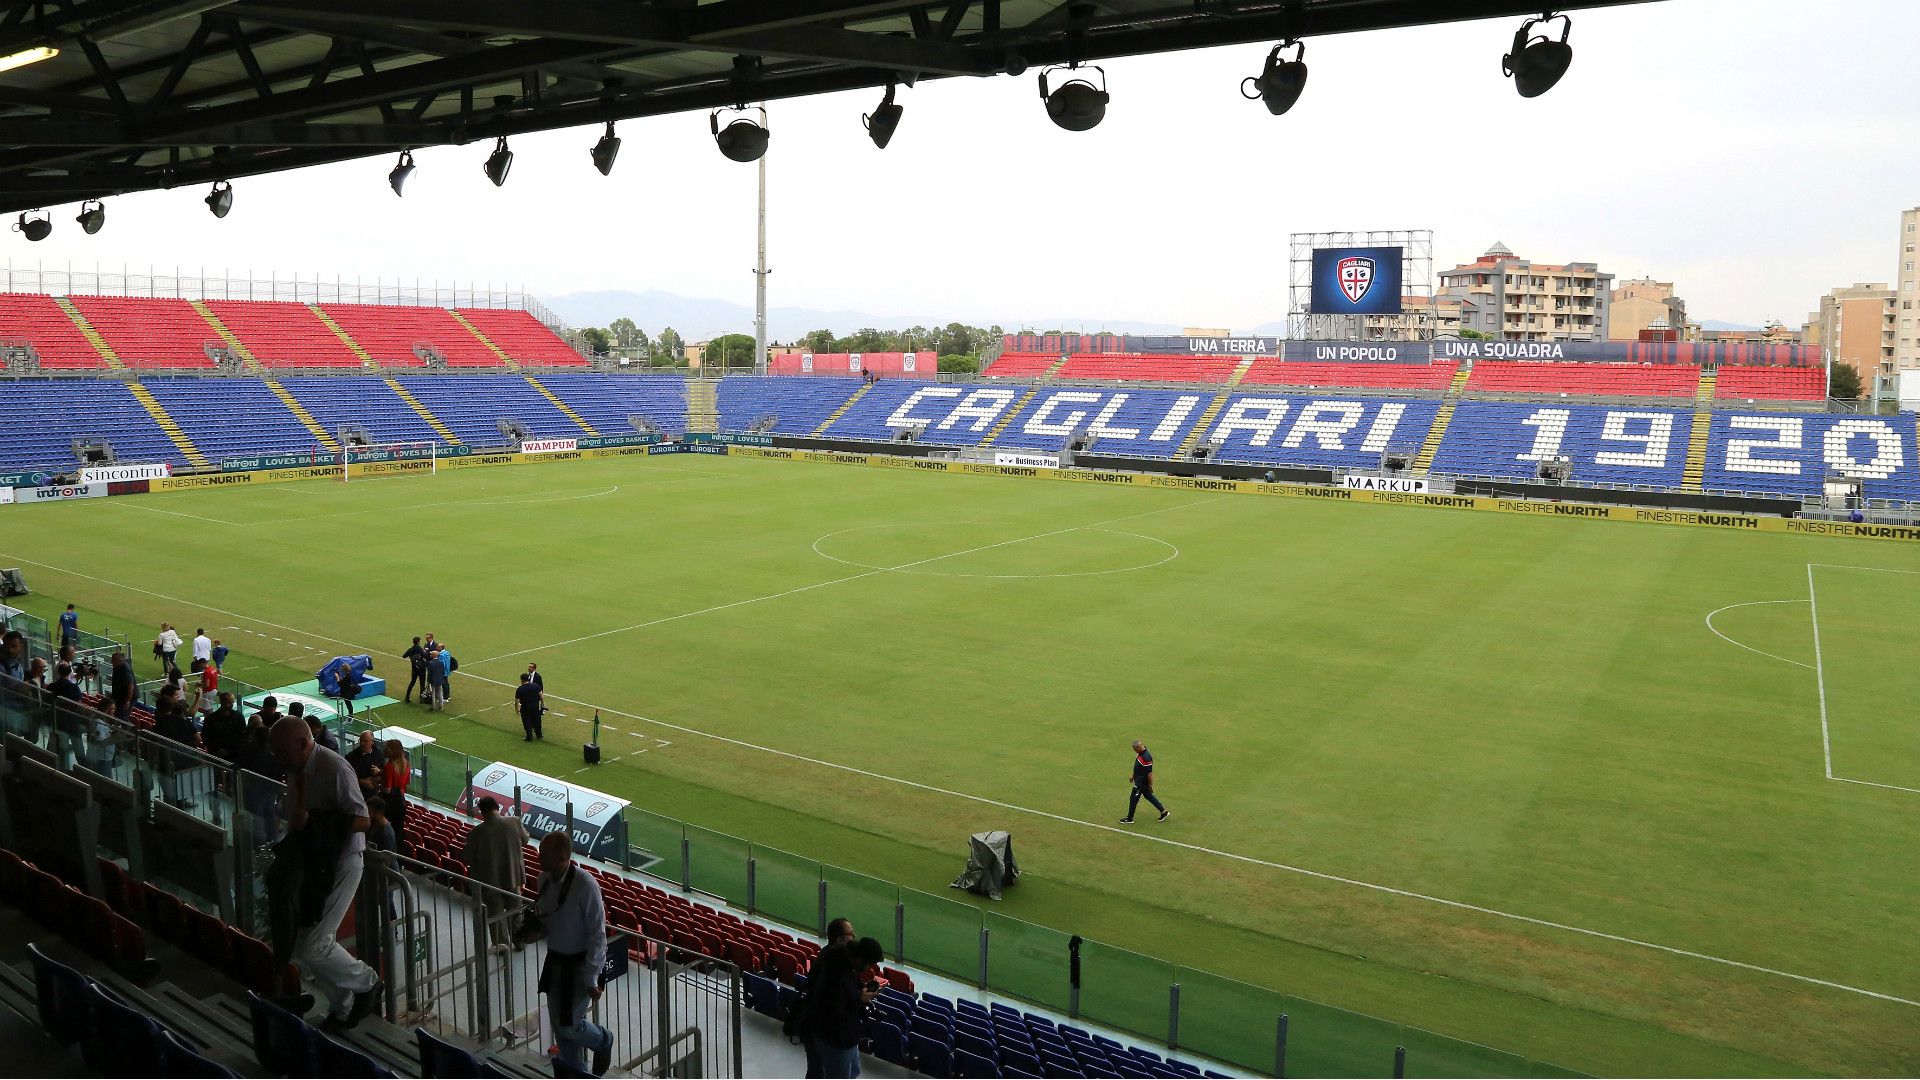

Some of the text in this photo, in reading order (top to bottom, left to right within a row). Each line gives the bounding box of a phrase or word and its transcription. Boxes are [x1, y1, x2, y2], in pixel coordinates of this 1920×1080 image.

[1342, 260, 1371, 269] CAGLIARI
[1189, 339, 1267, 354] UNA TERRA
[1445, 342, 1563, 361] UNA SQUADRA
[1316, 346, 1397, 362] UN POPOLO
[885, 386, 1904, 479] CAGLIARI 1920
[523, 440, 576, 451] WAMPUM
[649, 445, 720, 454] EUROBET EUROBET
[393, 449, 420, 457] LOVES
[265, 457, 297, 466] LOVES
[1015, 457, 1057, 467] Business Plan
[85, 467, 163, 481] sincontru
[1348, 476, 1424, 492] MARKUP
[37, 485, 90, 498] infront
[522, 783, 566, 801] macron
